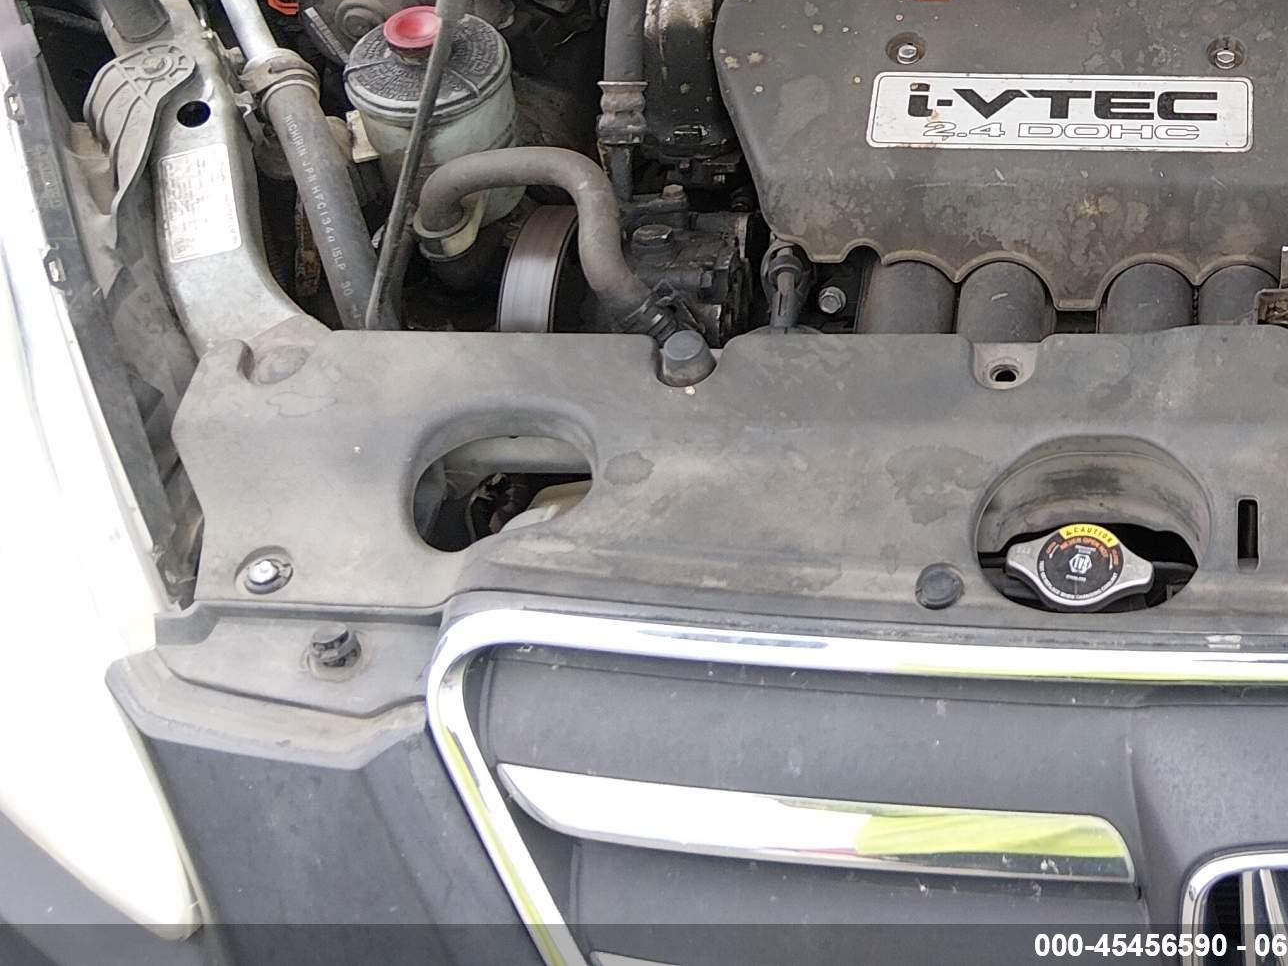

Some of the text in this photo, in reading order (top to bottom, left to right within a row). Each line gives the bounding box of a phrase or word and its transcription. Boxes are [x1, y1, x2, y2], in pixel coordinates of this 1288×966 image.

[908, 82, 1218, 122] i-VTEC
[923, 121, 1200, 140] 2.4 DOHC
[1073, 526, 1113, 543] CAUTION
